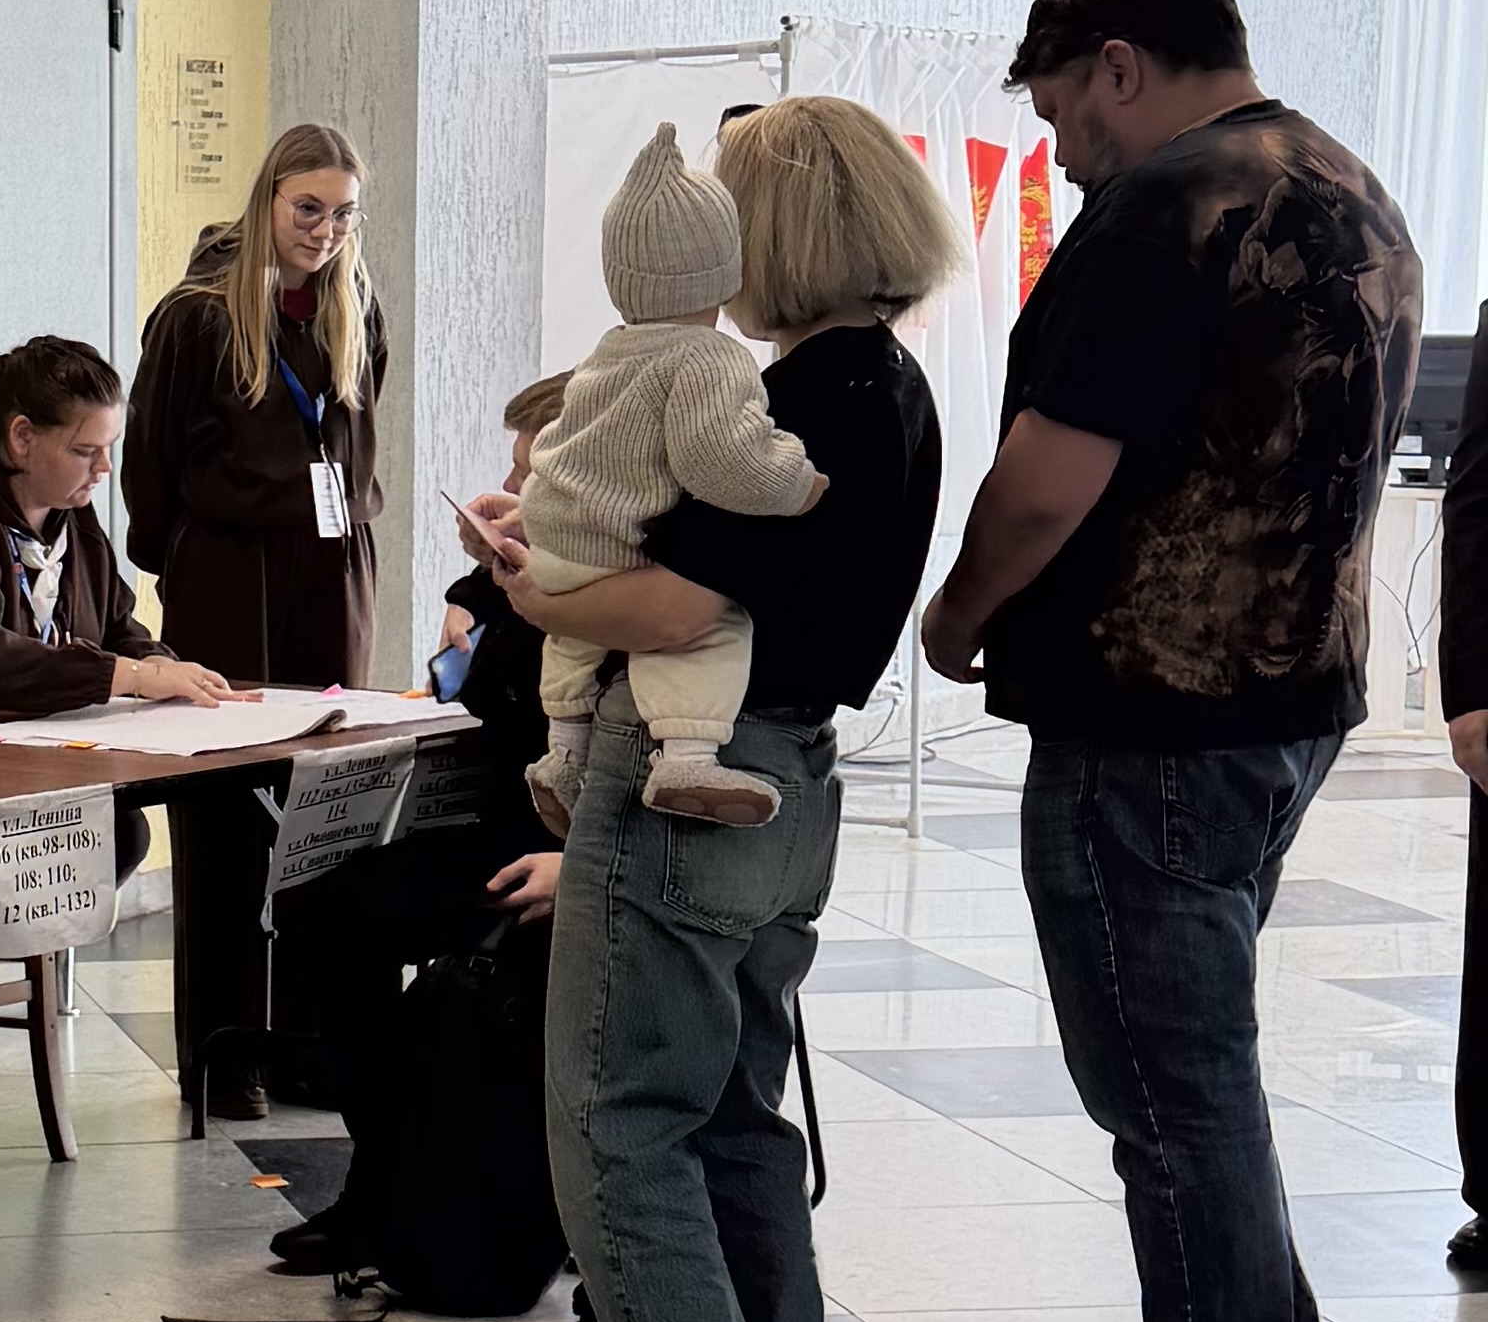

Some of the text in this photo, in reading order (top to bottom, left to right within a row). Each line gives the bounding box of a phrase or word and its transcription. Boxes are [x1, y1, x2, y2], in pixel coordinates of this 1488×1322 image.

[2, 806, 82, 833] ул.Ленина
[16, 830, 102, 865] (кв.98-108);
[15, 863, 76, 892] 108; 110;
[25, 889, 97, 925] (кв.1-132)
